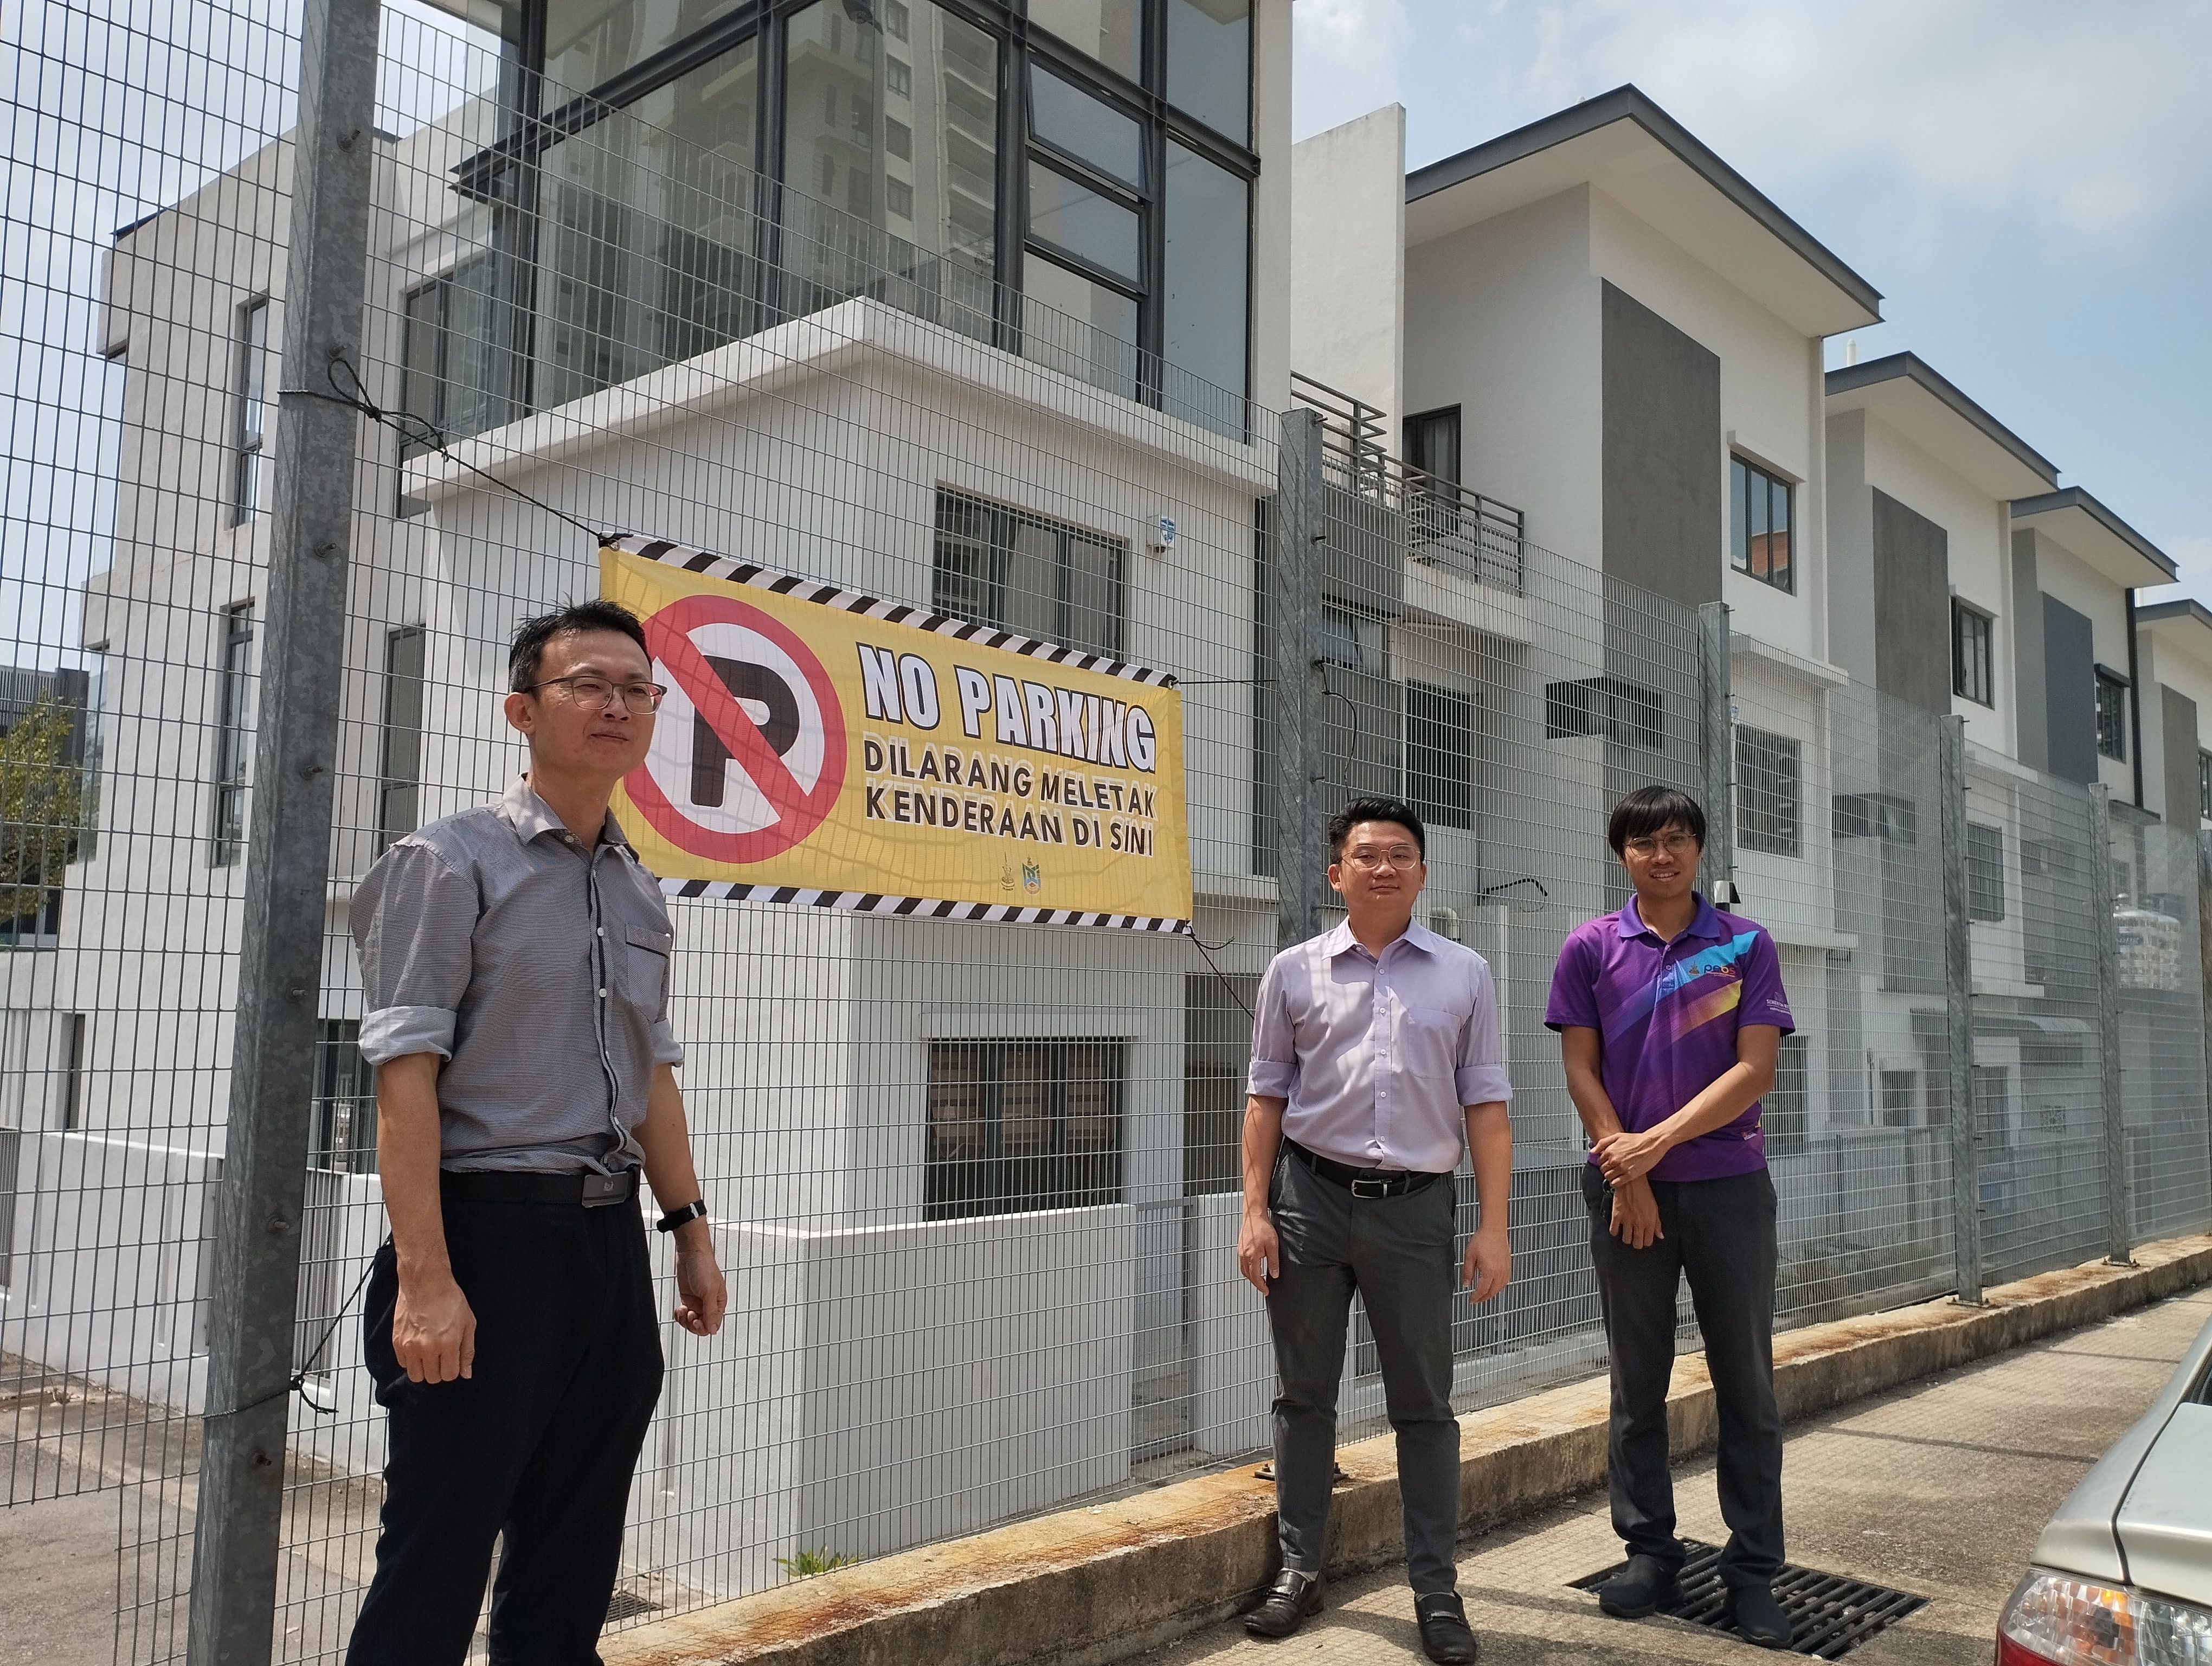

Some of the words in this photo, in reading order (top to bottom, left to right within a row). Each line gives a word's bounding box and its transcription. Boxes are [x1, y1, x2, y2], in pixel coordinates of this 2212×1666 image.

[855, 641, 941, 731] NO
[953, 664, 1156, 774] PARKING
[864, 735, 1033, 798] DILARANG
[1040, 770, 1155, 819] MELETAK
[866, 783, 1063, 844] KENDERAAN
[1072, 816, 1102, 849] DI
[1109, 821, 1153, 857] SINI
